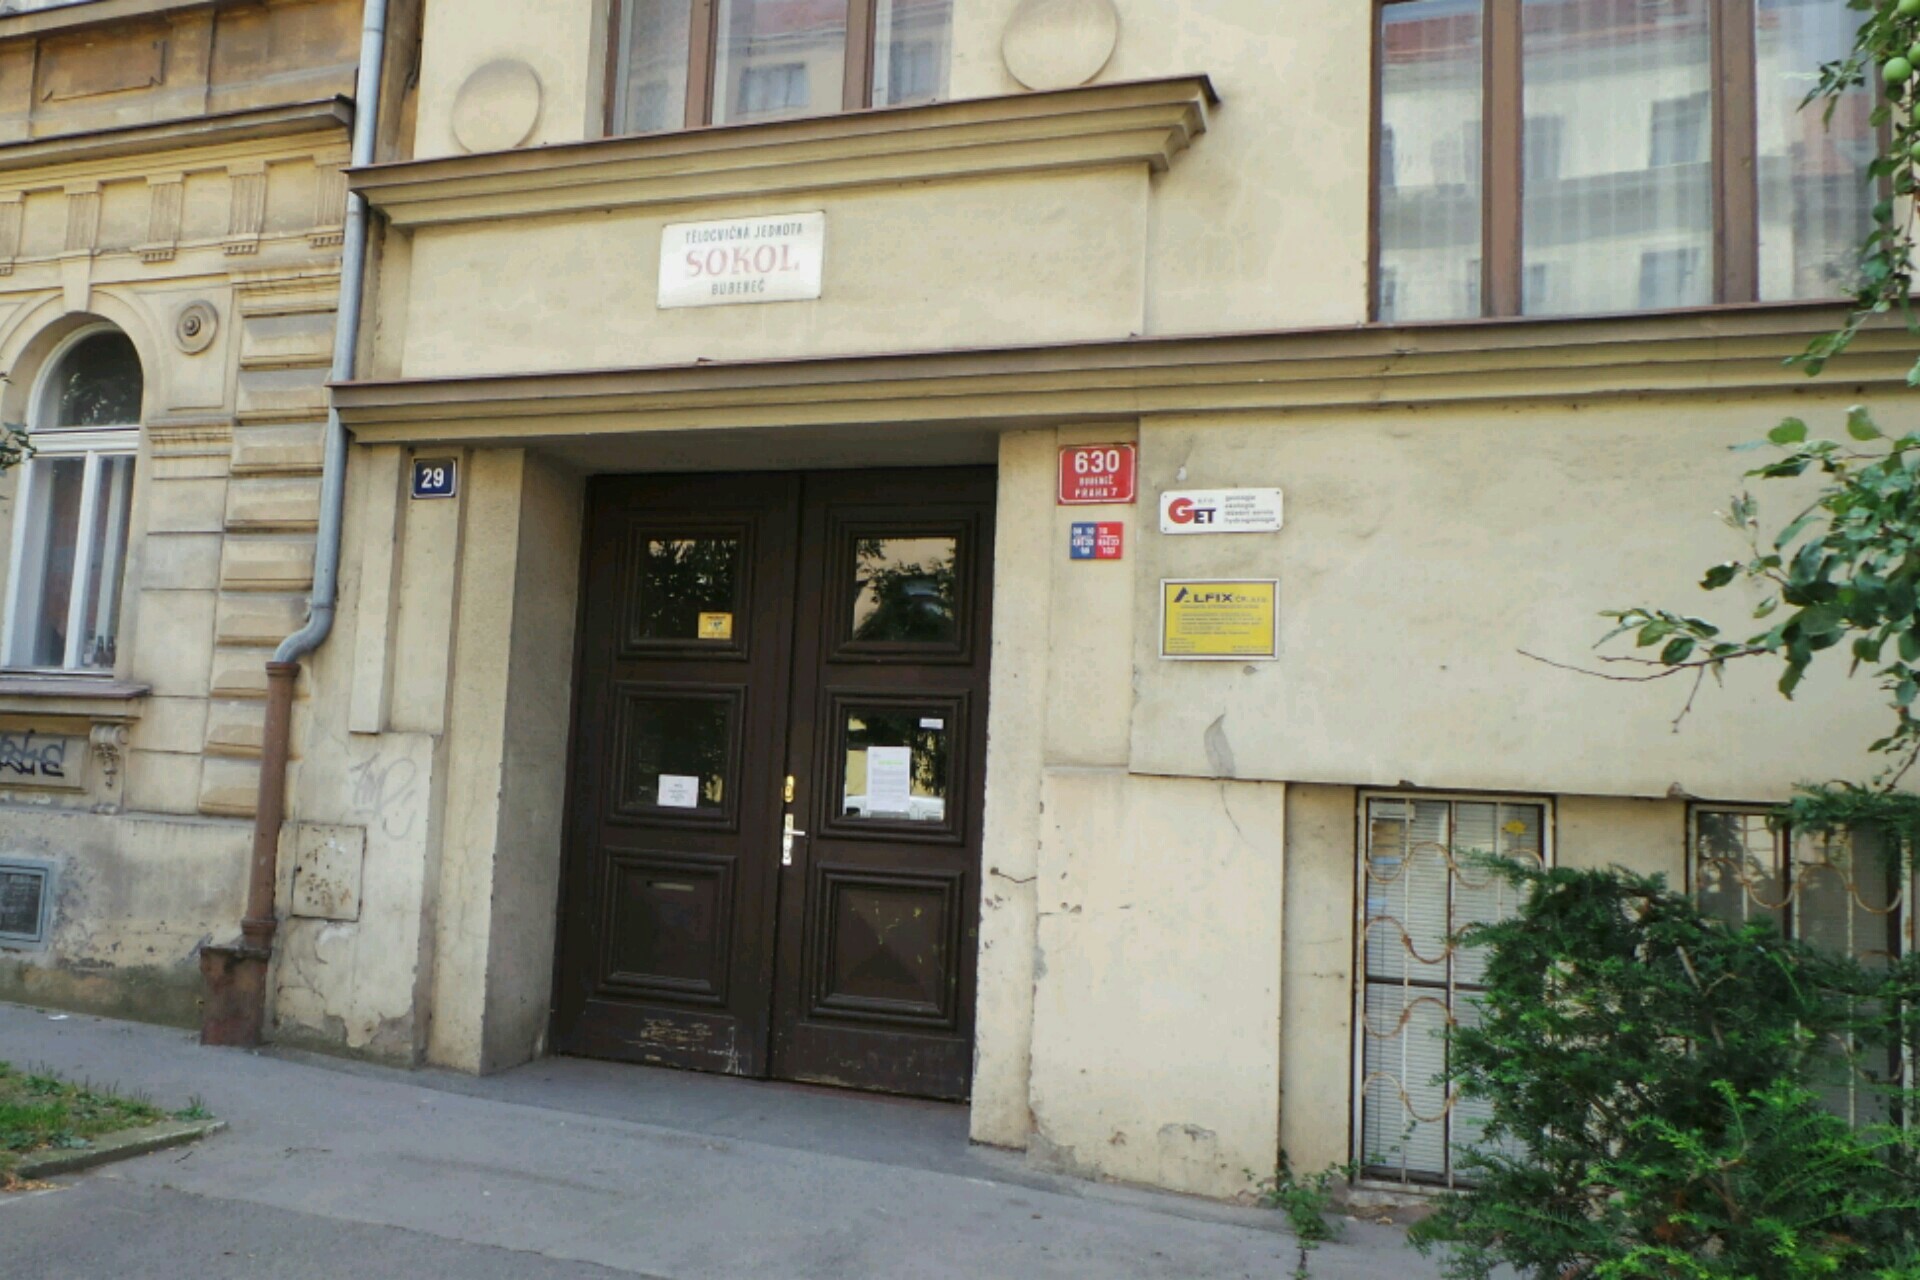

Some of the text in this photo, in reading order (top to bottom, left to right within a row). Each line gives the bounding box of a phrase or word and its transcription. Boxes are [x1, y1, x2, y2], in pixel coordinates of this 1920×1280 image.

[754, 222, 802, 238] JEDNOTA
[686, 244, 800, 277] SOKOL
[1075, 449, 1120, 474] 630
[421, 467, 444, 489] 29
[1075, 487, 1118, 498] PRAHA 7
[1168, 497, 1217, 524] GET
[1174, 586, 1233, 603] ALFIX
